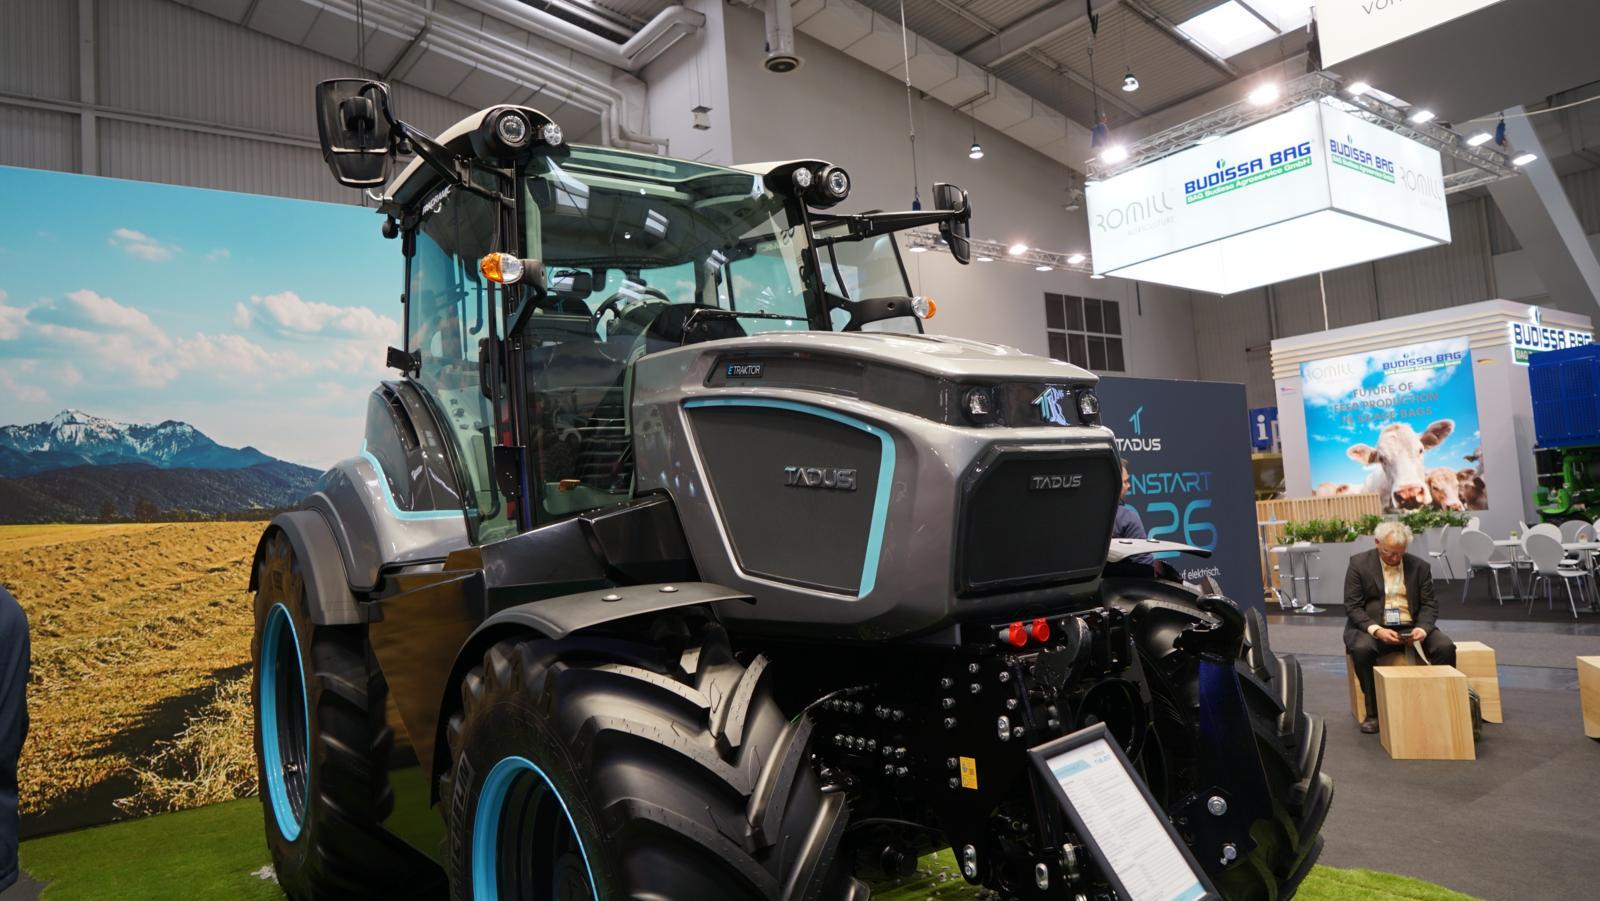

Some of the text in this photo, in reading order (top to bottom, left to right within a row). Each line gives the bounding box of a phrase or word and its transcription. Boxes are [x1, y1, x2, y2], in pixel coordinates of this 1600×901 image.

[1330, 139, 1373, 166] BUDISSA
[1375, 156, 1395, 173] BAG
[1185, 141, 1311, 194] BUDISSA BAG
[1513, 323, 1566, 350] BUDISSA
[1382, 355, 1433, 370] BUDISSA
[1436, 351, 1462, 362] BAG
[1353, 384, 1395, 398] FUTURE
[1398, 382, 1413, 391] OF
[1115, 438, 1162, 451] TADUS
[784, 466, 857, 490] TADUS
[1033, 475, 1082, 489] TADUS
